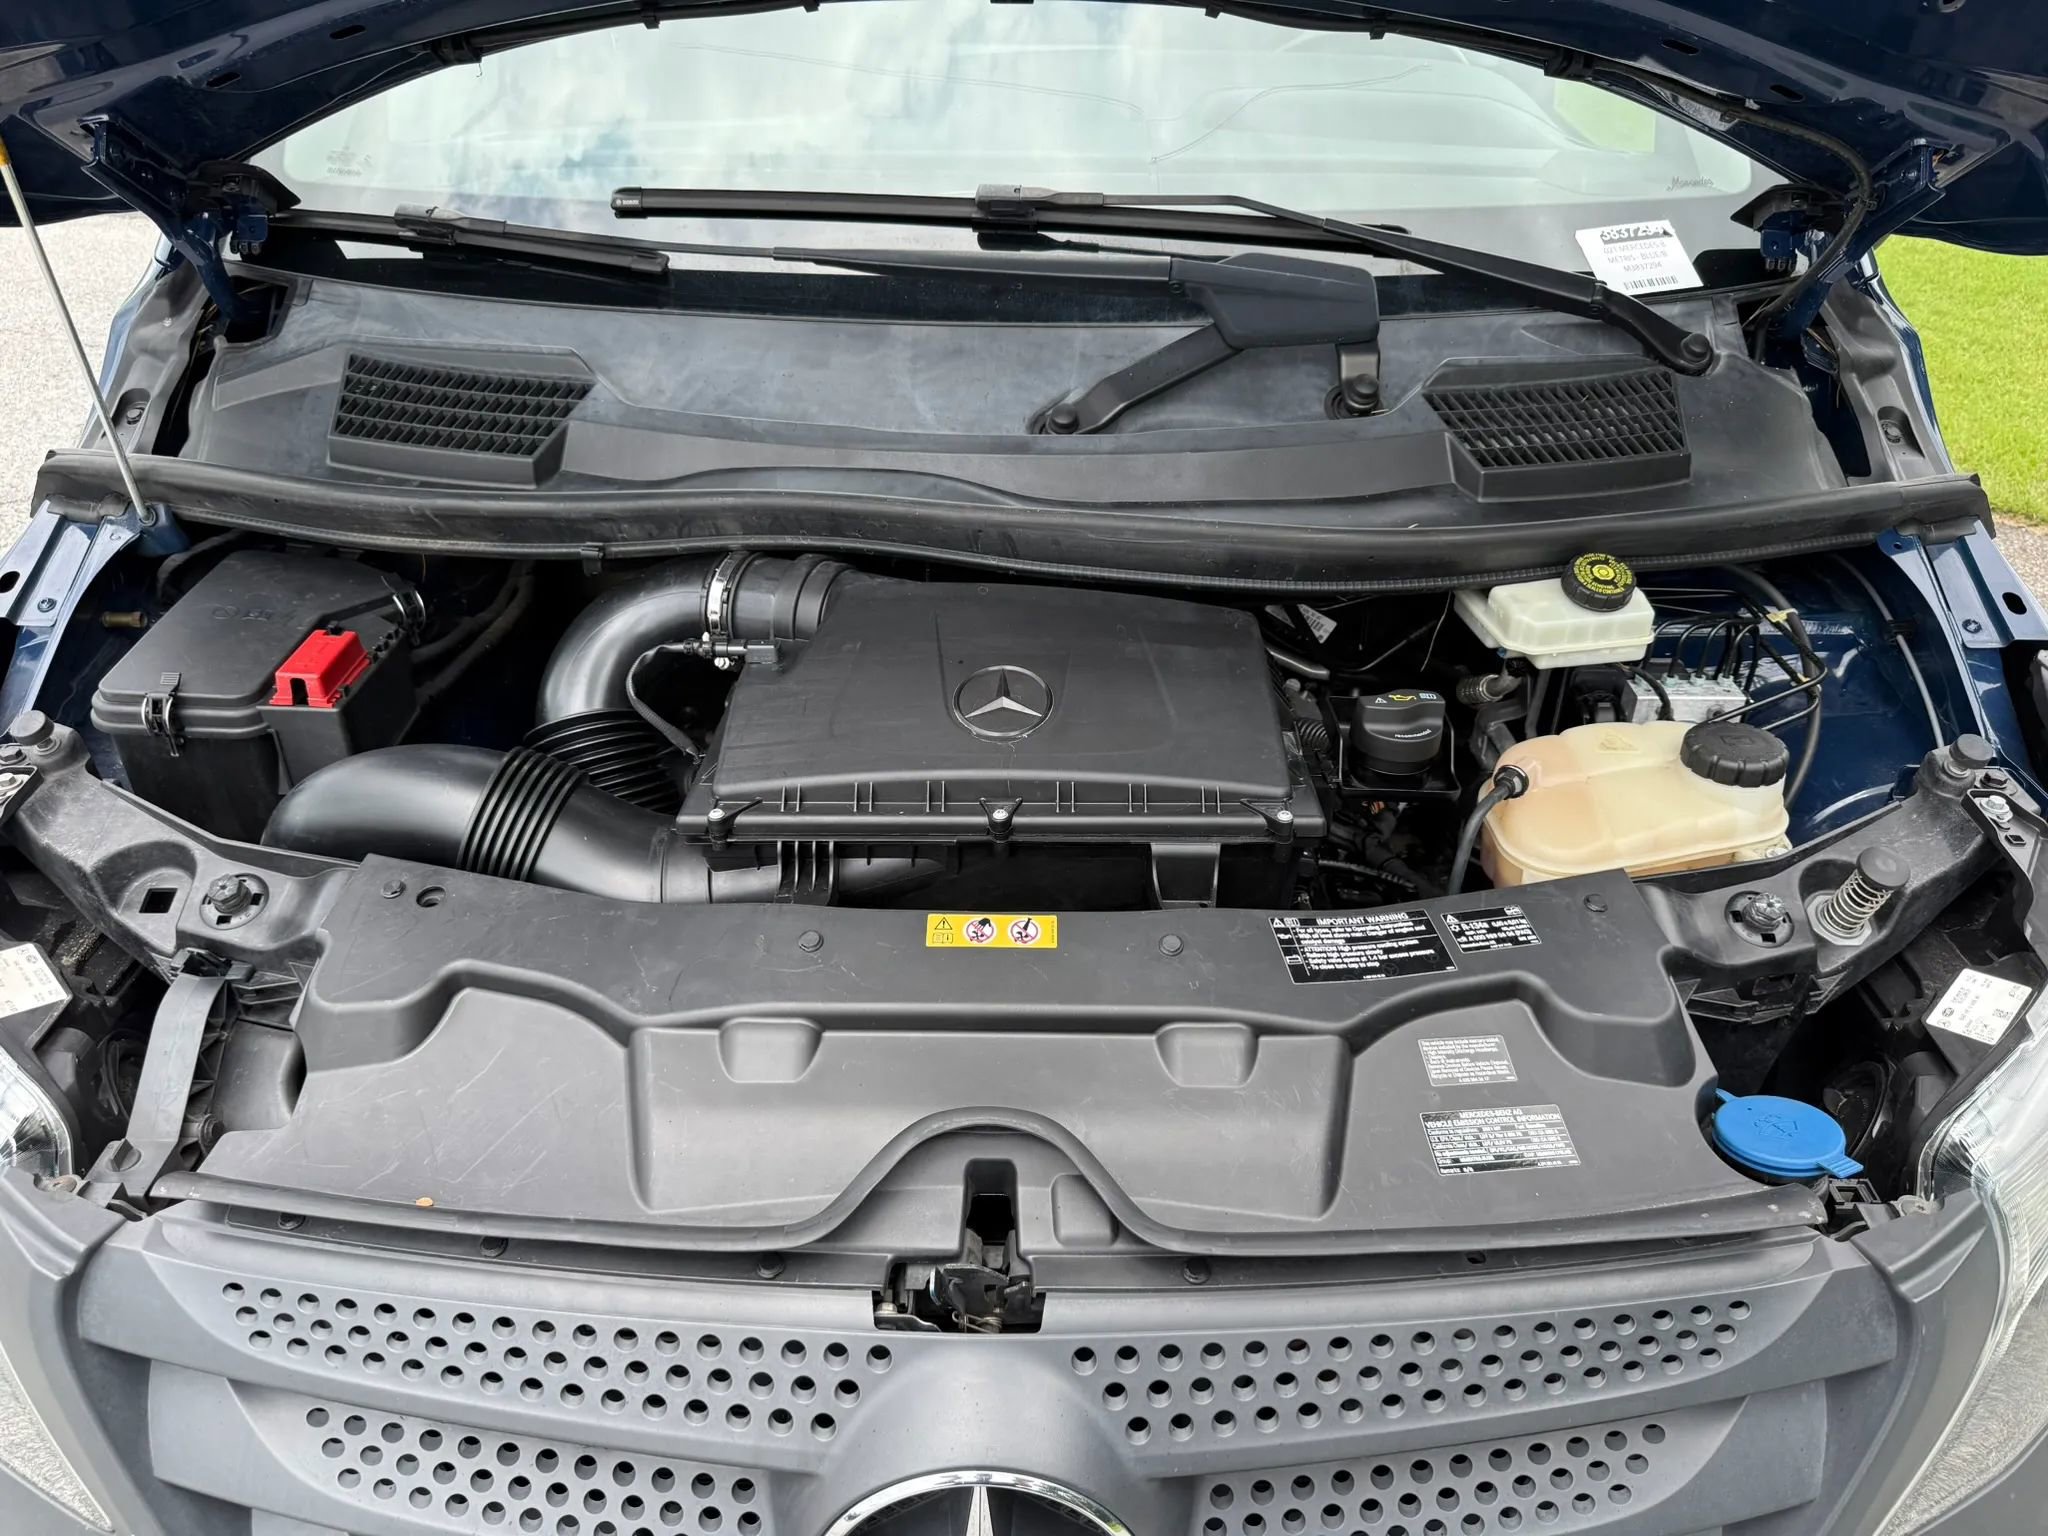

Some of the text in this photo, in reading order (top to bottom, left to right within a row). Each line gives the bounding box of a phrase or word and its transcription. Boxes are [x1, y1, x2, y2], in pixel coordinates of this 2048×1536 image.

[1316, 912, 1410, 926] IMPORTANT WARNING
[1460, 921, 1490, 931] R-134a
[1459, 1109, 1513, 1119] MERCEDES-BENZ
[1425, 1113, 1561, 1128] VEHICLE EMISSION CONTROL INFORMATION
